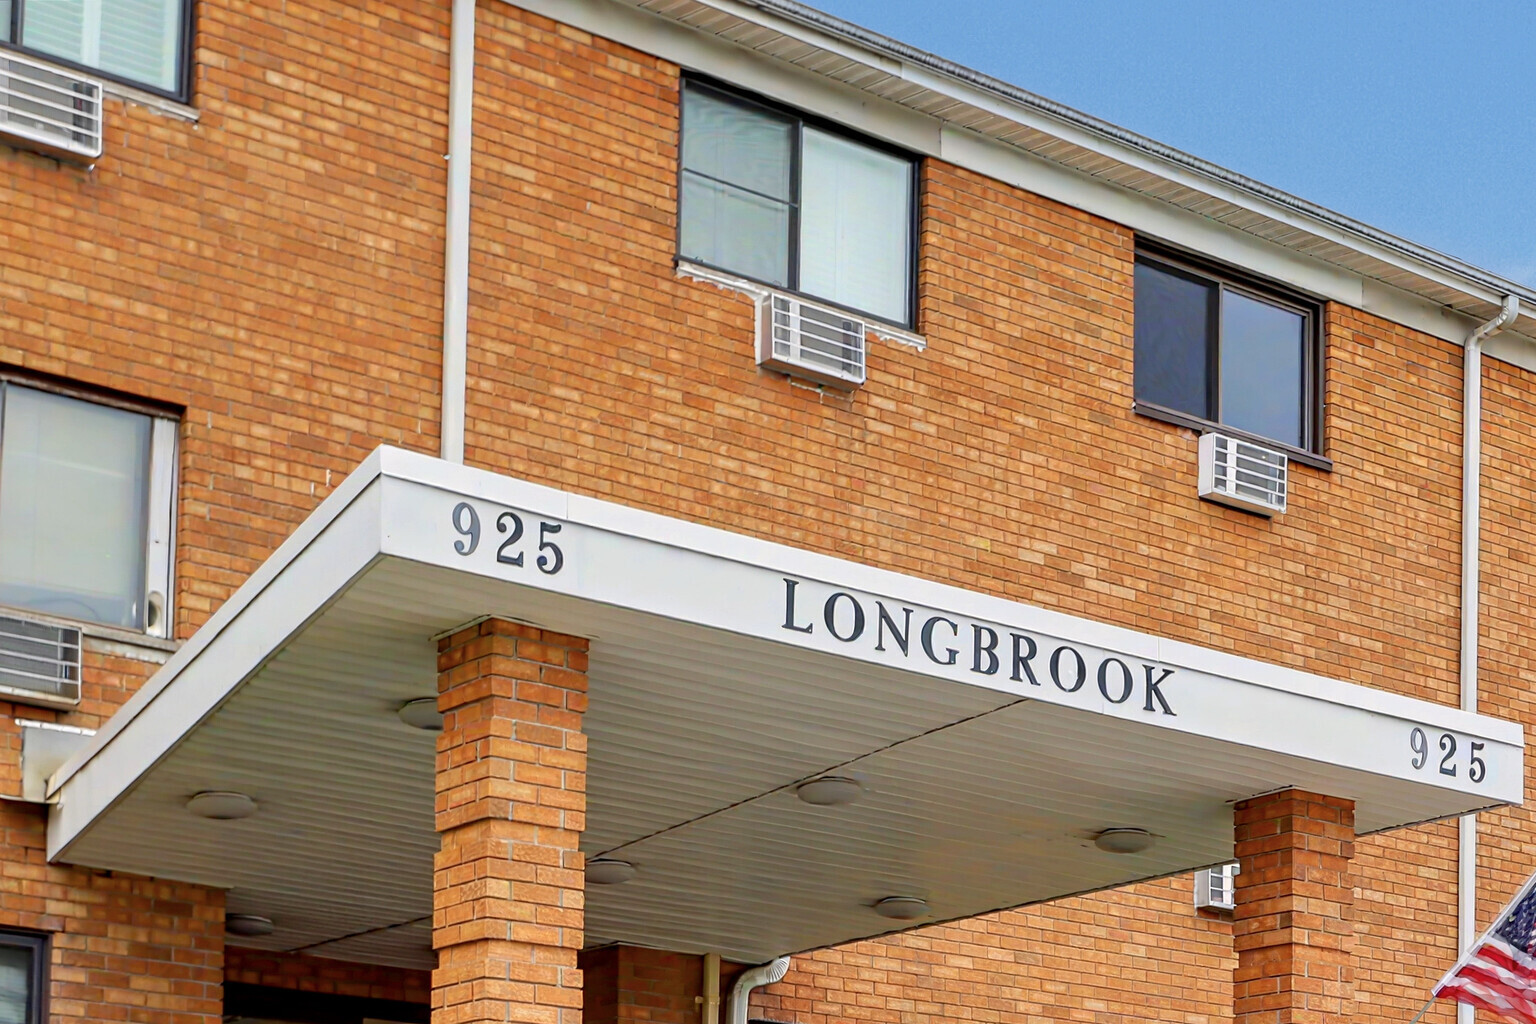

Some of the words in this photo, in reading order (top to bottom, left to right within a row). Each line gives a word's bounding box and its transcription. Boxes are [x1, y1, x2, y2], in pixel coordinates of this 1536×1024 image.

[452, 502, 564, 575] 925
[781, 578, 1177, 717] LONGBROOK
[1410, 727, 1486, 783] 925
